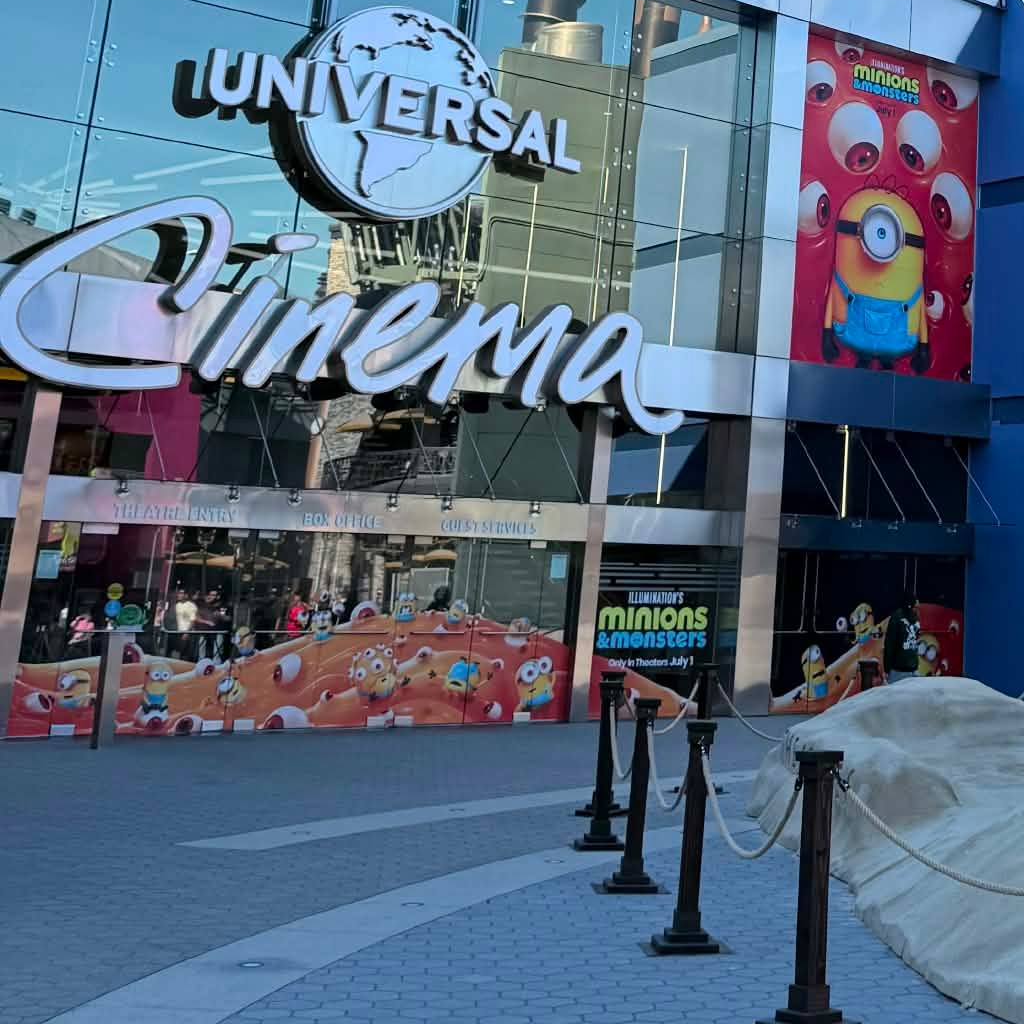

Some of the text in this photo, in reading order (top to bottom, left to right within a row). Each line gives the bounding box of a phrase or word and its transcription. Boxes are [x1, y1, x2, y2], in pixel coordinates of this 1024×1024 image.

[853, 64, 920, 94] minions
[207, 48, 581, 174] UNIVERSAL
[0, 195, 685, 436] Cinema
[113, 503, 239, 523] THEATRE ENTRY
[303, 512, 382, 529] BOX OFFICE
[441, 519, 537, 536] GUEST SERVICES
[628, 591, 684, 605] ILLUMINATION'S
[598, 606, 709, 630] minions
[608, 658, 626, 669] Only
[669, 656, 689, 669] July
